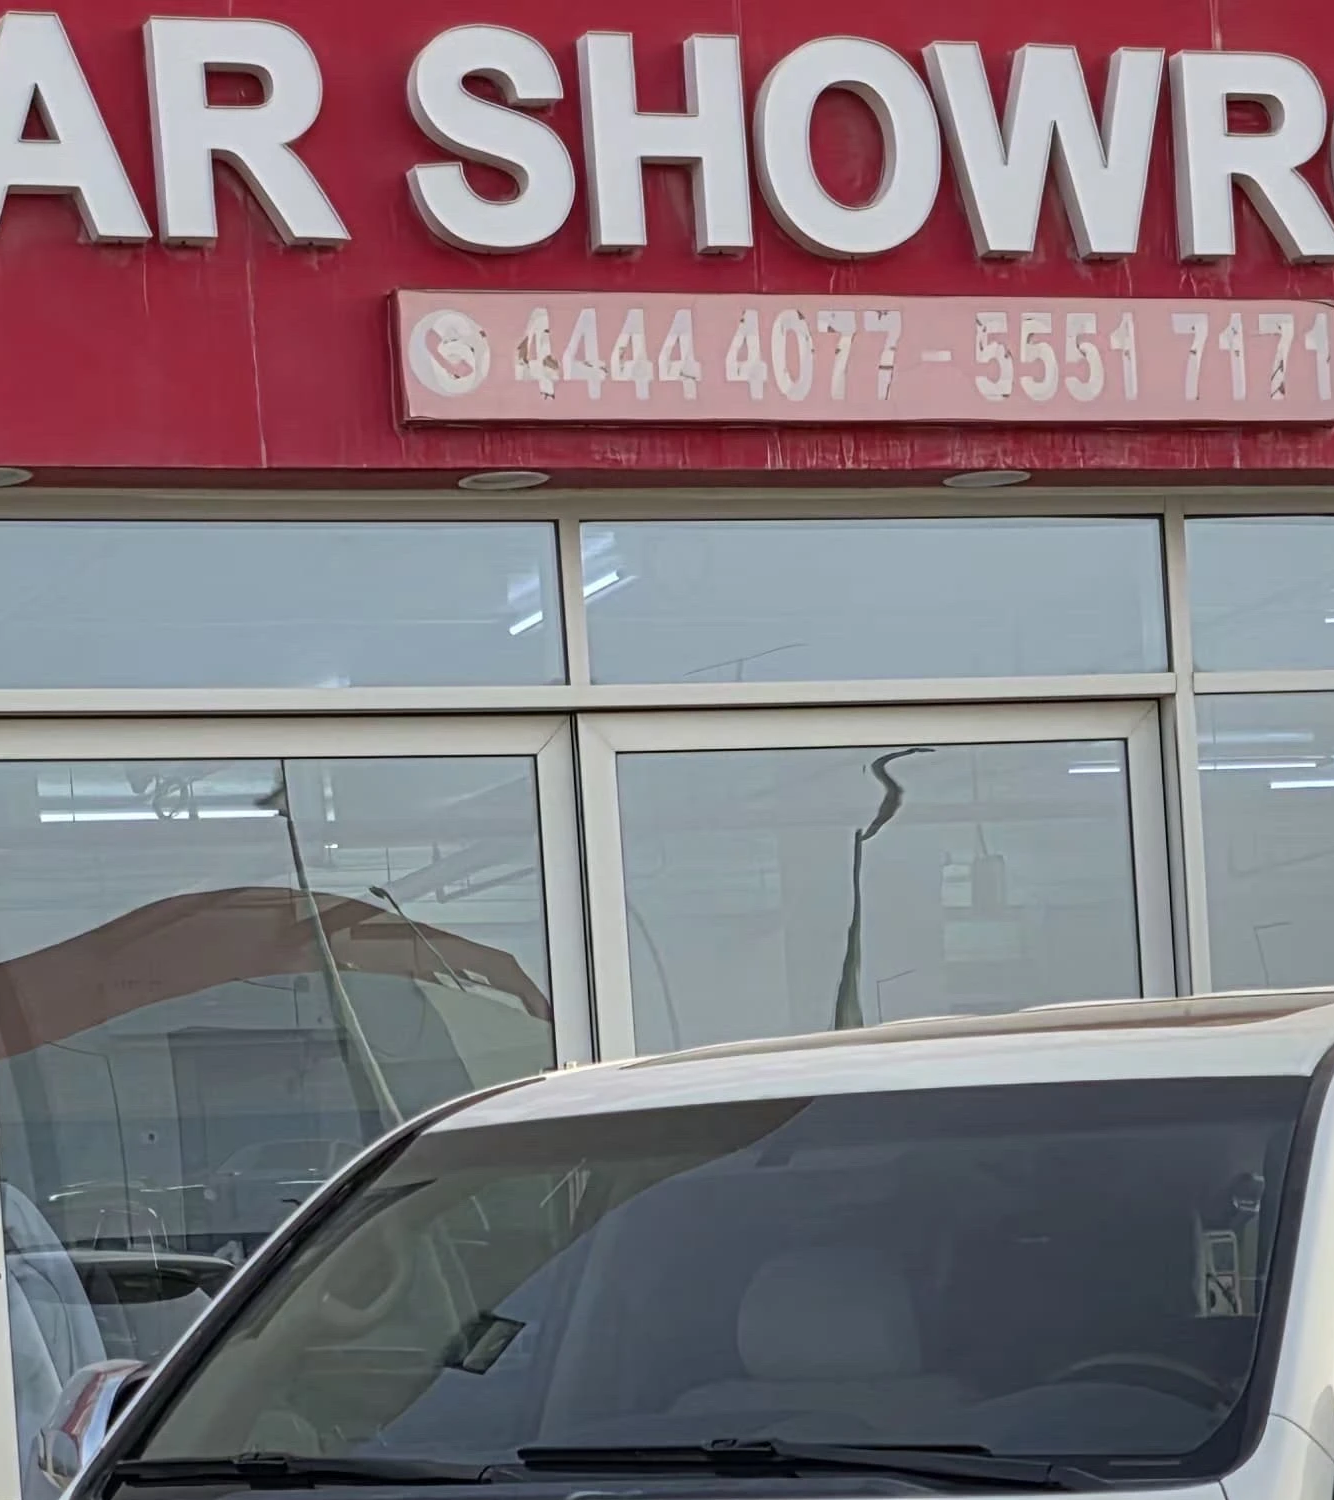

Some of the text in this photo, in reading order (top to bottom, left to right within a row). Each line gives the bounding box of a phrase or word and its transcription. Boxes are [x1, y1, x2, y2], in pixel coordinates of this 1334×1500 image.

[515, 307, 701, 400] 4444
[726, 308, 902, 400] 4077
[974, 312, 1138, 402] 5551
[1170, 312, 1334, 402] 7171
